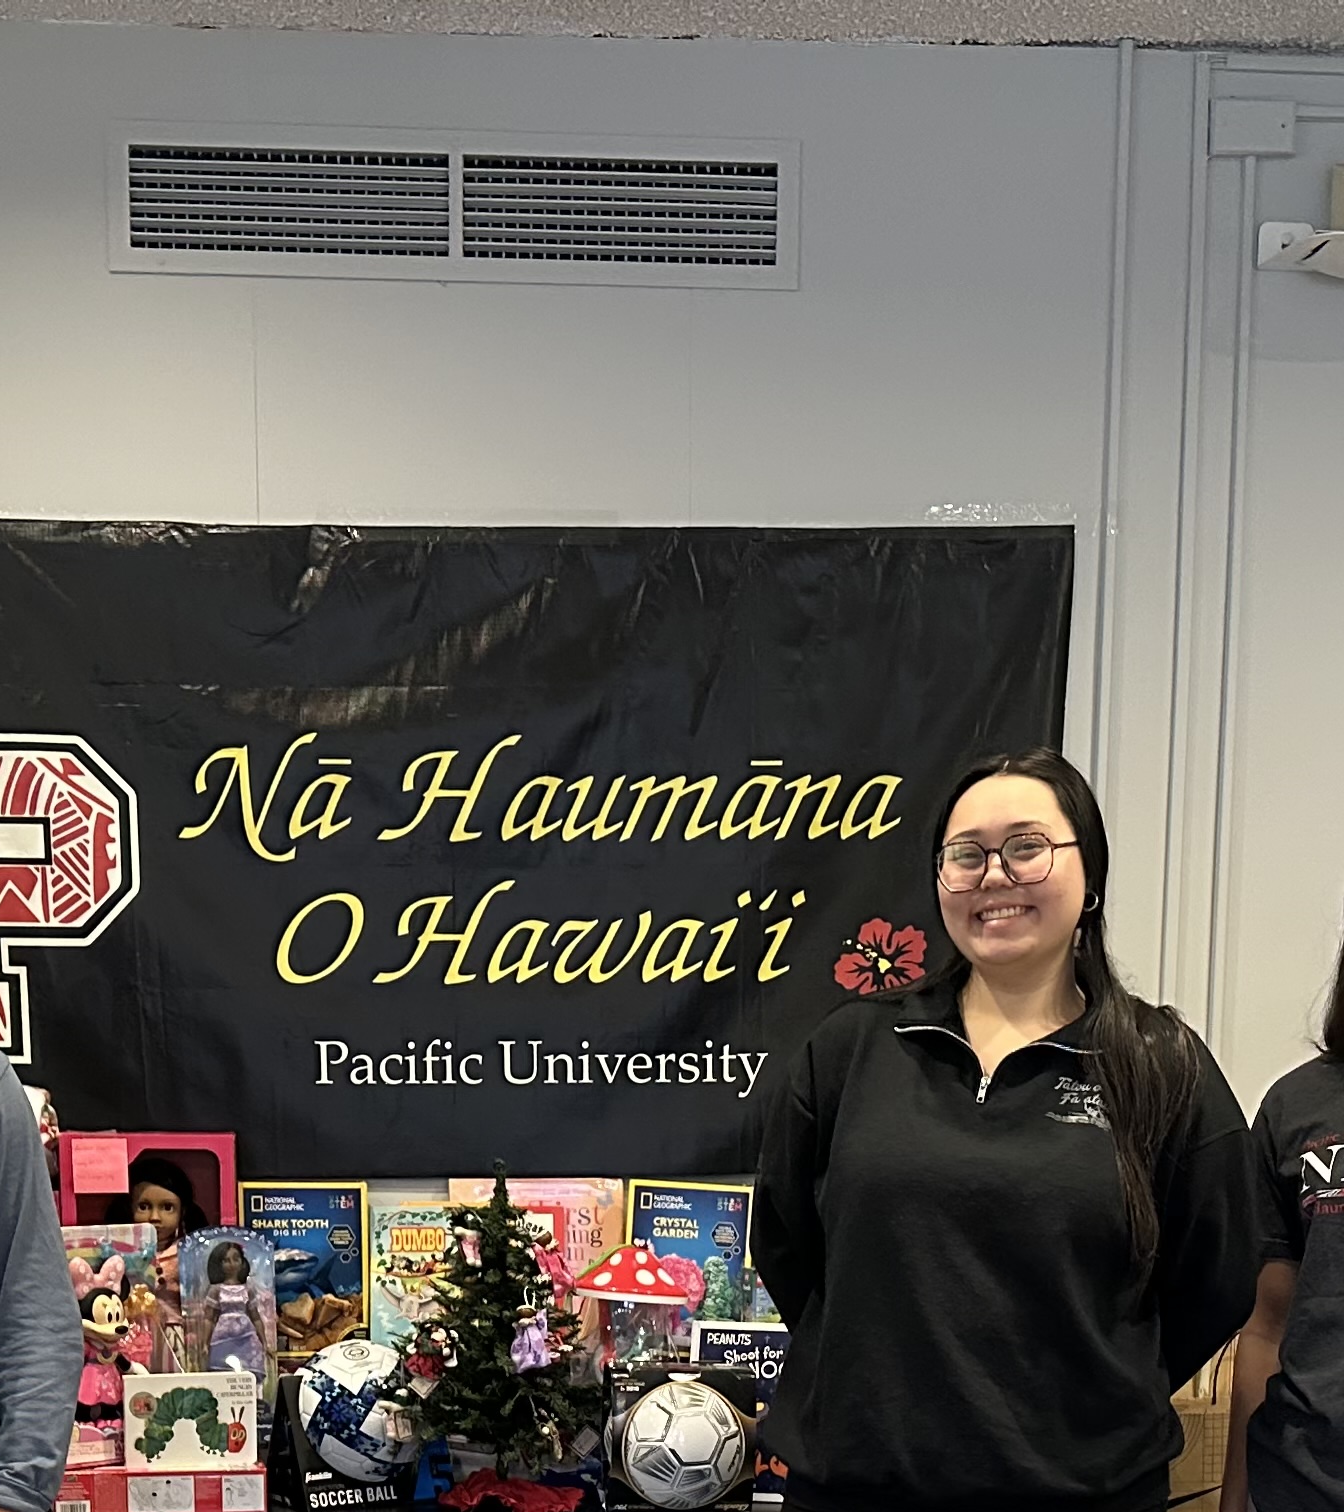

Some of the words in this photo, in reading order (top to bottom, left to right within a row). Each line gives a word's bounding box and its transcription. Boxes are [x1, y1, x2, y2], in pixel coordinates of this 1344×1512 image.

[178, 732, 353, 861] Nā
[378, 735, 903, 843] Haumāna
[275, 892, 365, 984] O
[315, 1041, 483, 1086] Pacific
[499, 1041, 768, 1097] University
[653, 1202, 692, 1210] GEOGRAPHIC
[654, 1195, 684, 1203] NATIONAL
[252, 1219, 288, 1228] SHARK
[292, 1219, 329, 1228] TOOTH
[653, 1217, 699, 1228] CRYSTAL
[390, 1227, 445, 1251] DUMBO
[653, 1228, 699, 1239] GARDEN
[707, 1333, 752, 1345] PEANUTS
[724, 1346, 759, 1365] Shoot
[763, 1346, 783, 1359] for
[309, 1490, 363, 1508] SOCCER
[367, 1486, 397, 1501] BALL
